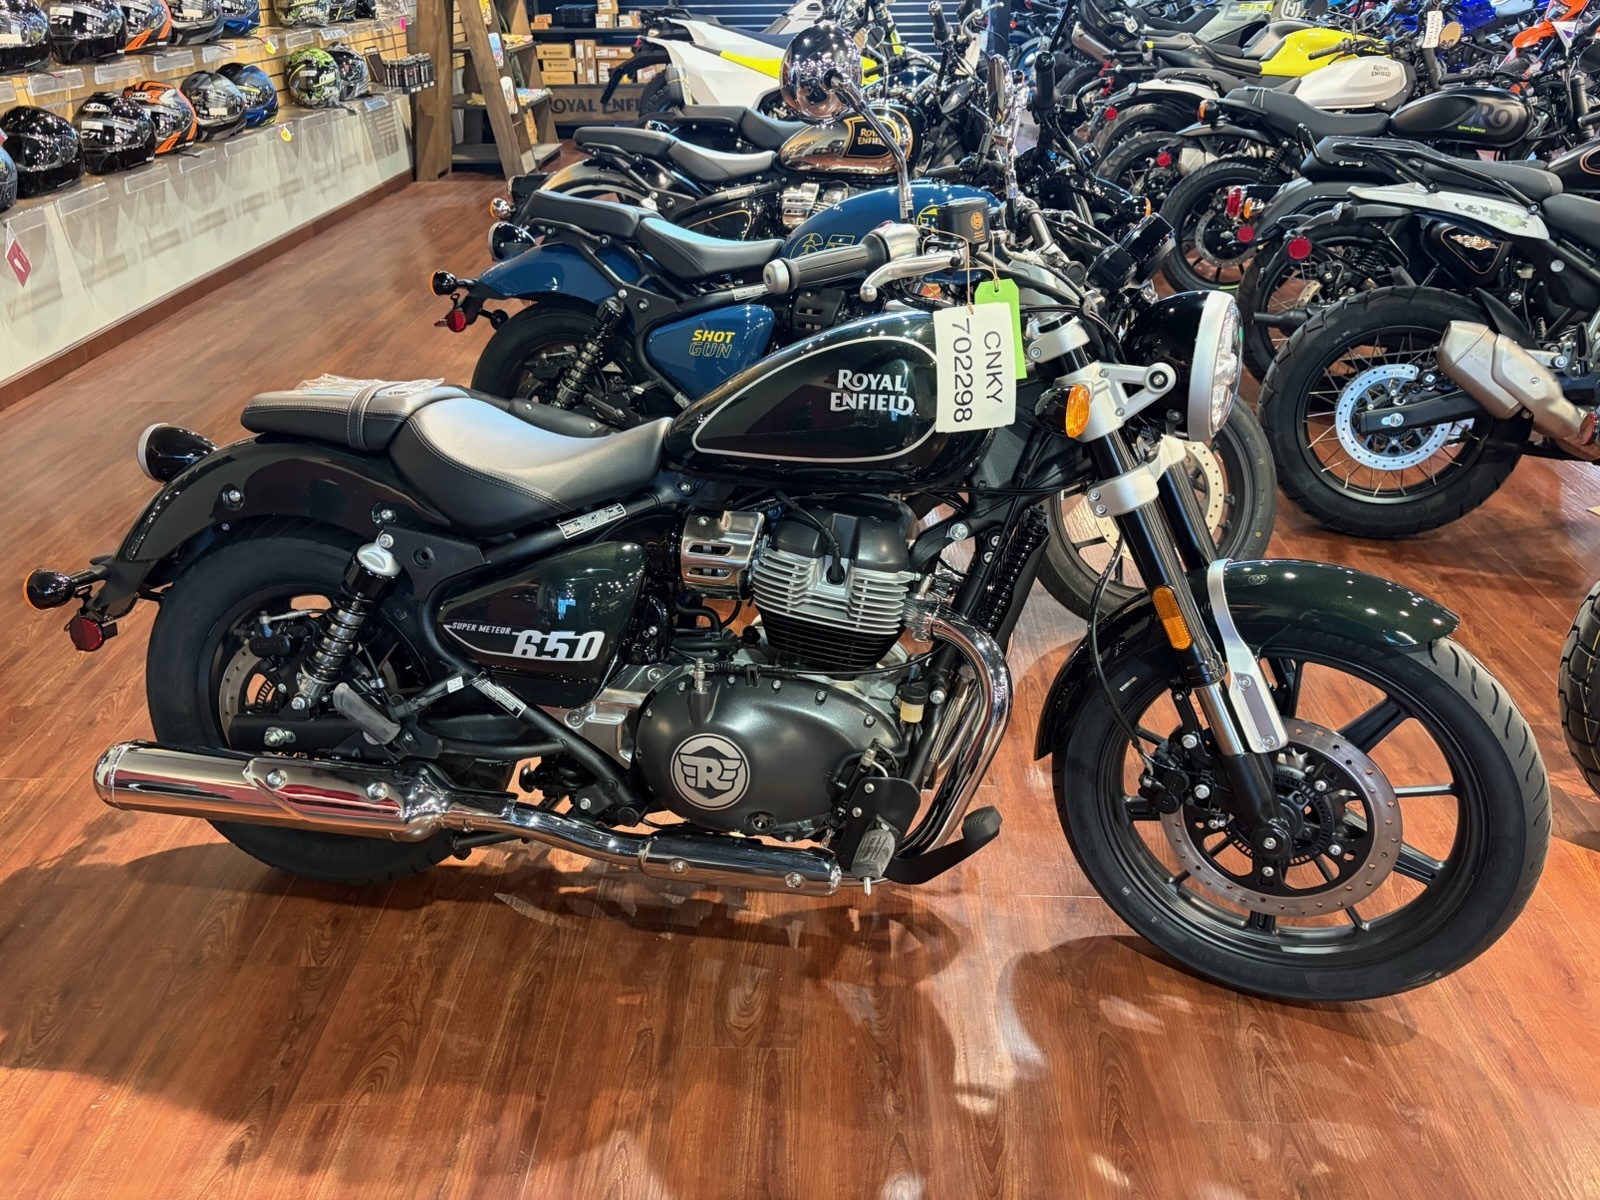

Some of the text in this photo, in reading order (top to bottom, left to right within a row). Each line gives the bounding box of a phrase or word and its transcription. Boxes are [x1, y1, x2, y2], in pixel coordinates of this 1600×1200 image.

[692, 329, 736, 344] SHOT
[689, 341, 733, 359] GUN
[951, 317, 974, 423] 702298
[984, 330, 1003, 404] CNKY
[837, 368, 908, 392] ROYAL
[830, 392, 915, 416] ENFIELD
[451, 621, 605, 662] SUPER METEOR 650
